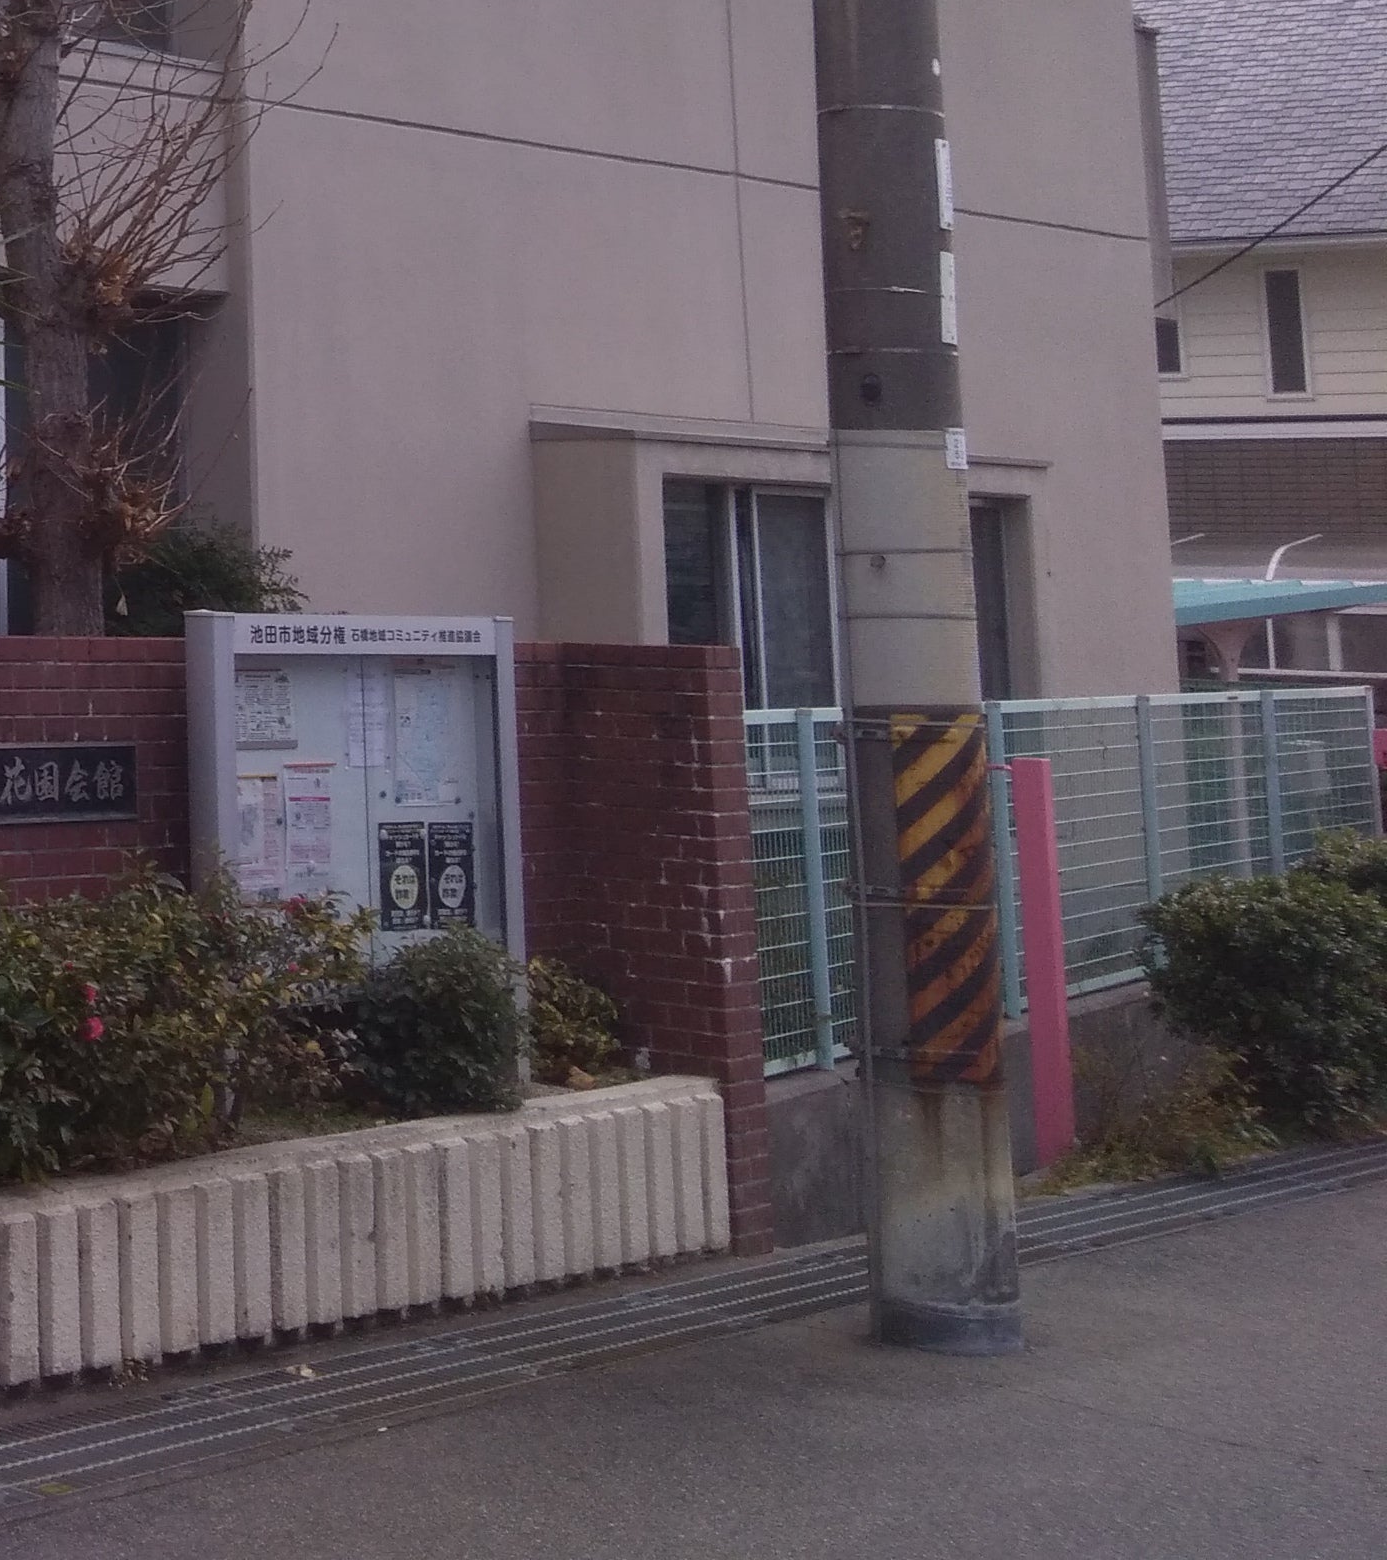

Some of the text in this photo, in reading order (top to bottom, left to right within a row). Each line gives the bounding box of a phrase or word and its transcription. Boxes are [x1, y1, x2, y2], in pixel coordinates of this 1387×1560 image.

[250, 624, 347, 645] 池田市地域分権
